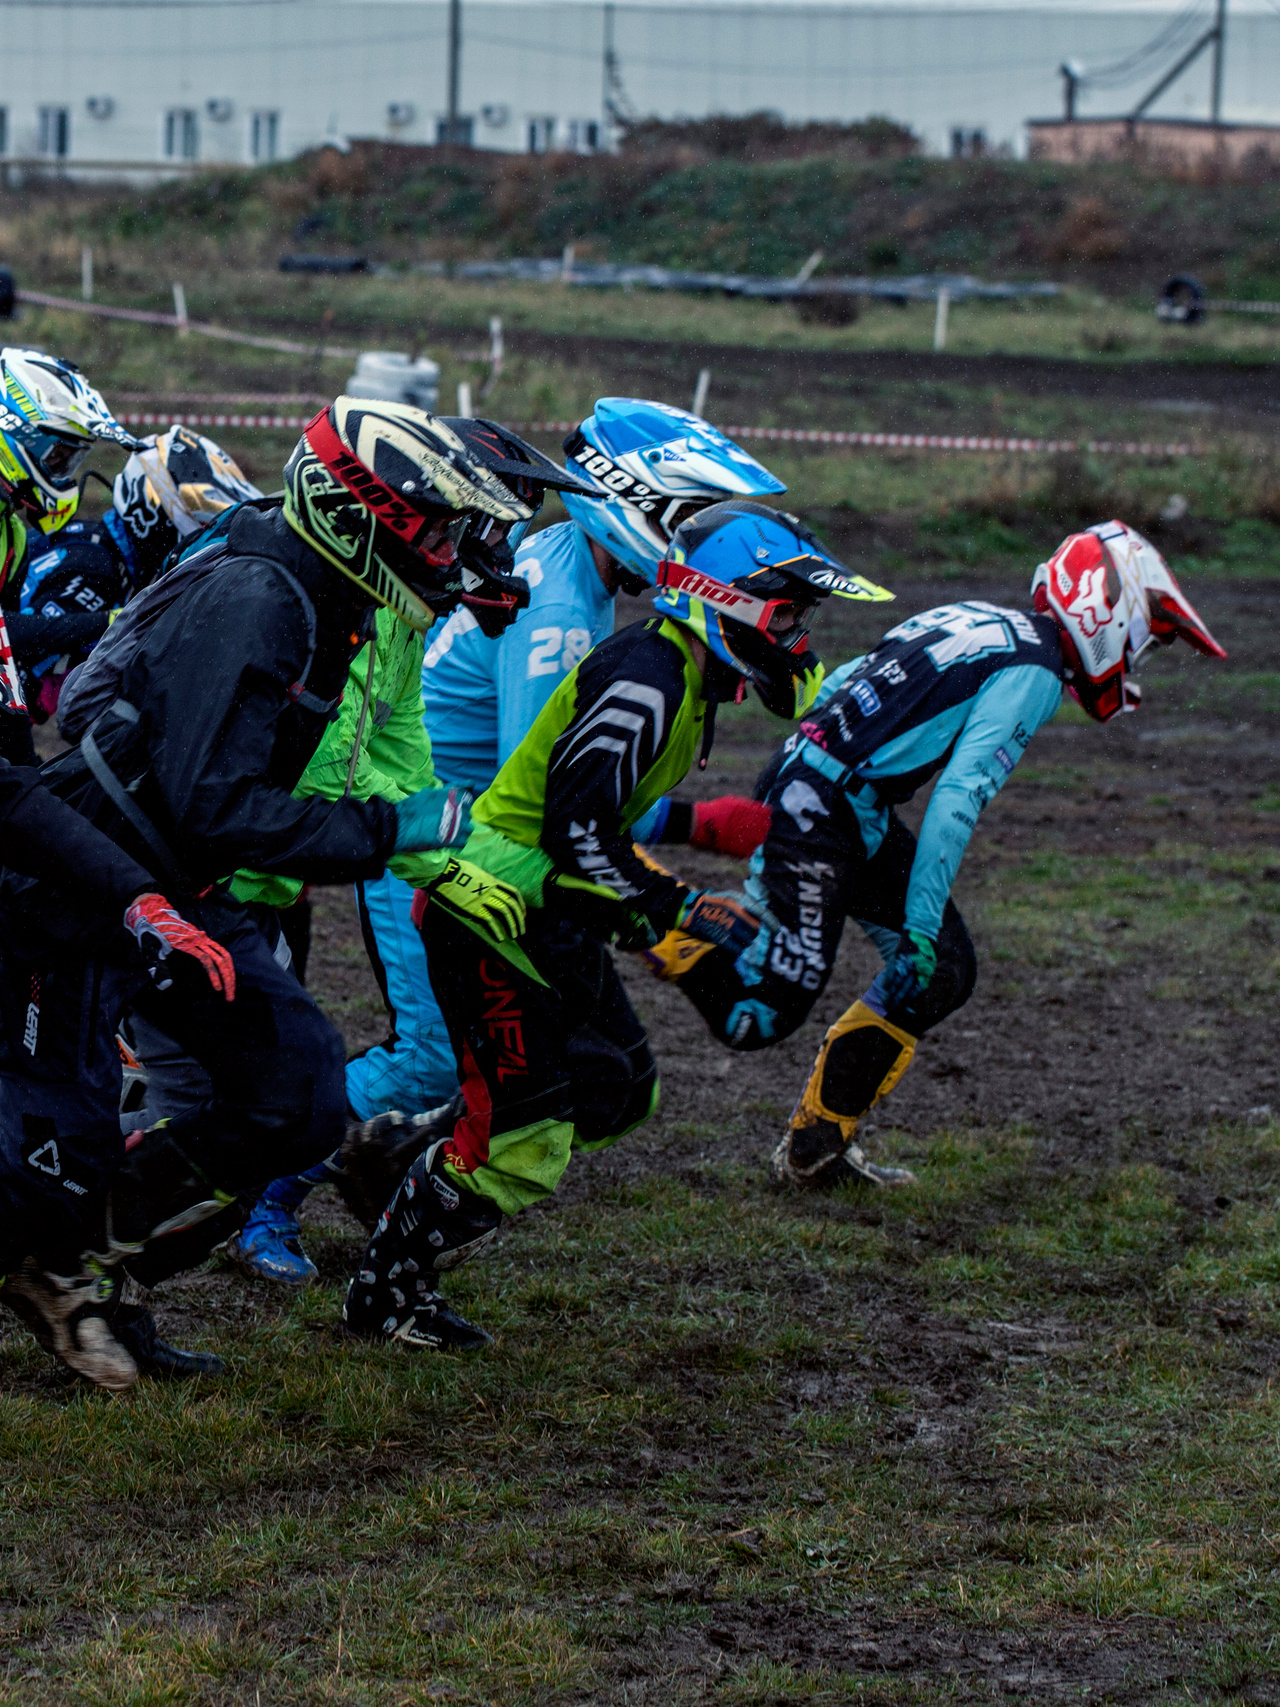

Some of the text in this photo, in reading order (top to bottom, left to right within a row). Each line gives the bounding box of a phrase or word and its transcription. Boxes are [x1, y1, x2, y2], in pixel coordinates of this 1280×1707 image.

[331, 451, 418, 532] 100%
[573, 444, 663, 514] 100%
[526, 626, 591, 680] 28
